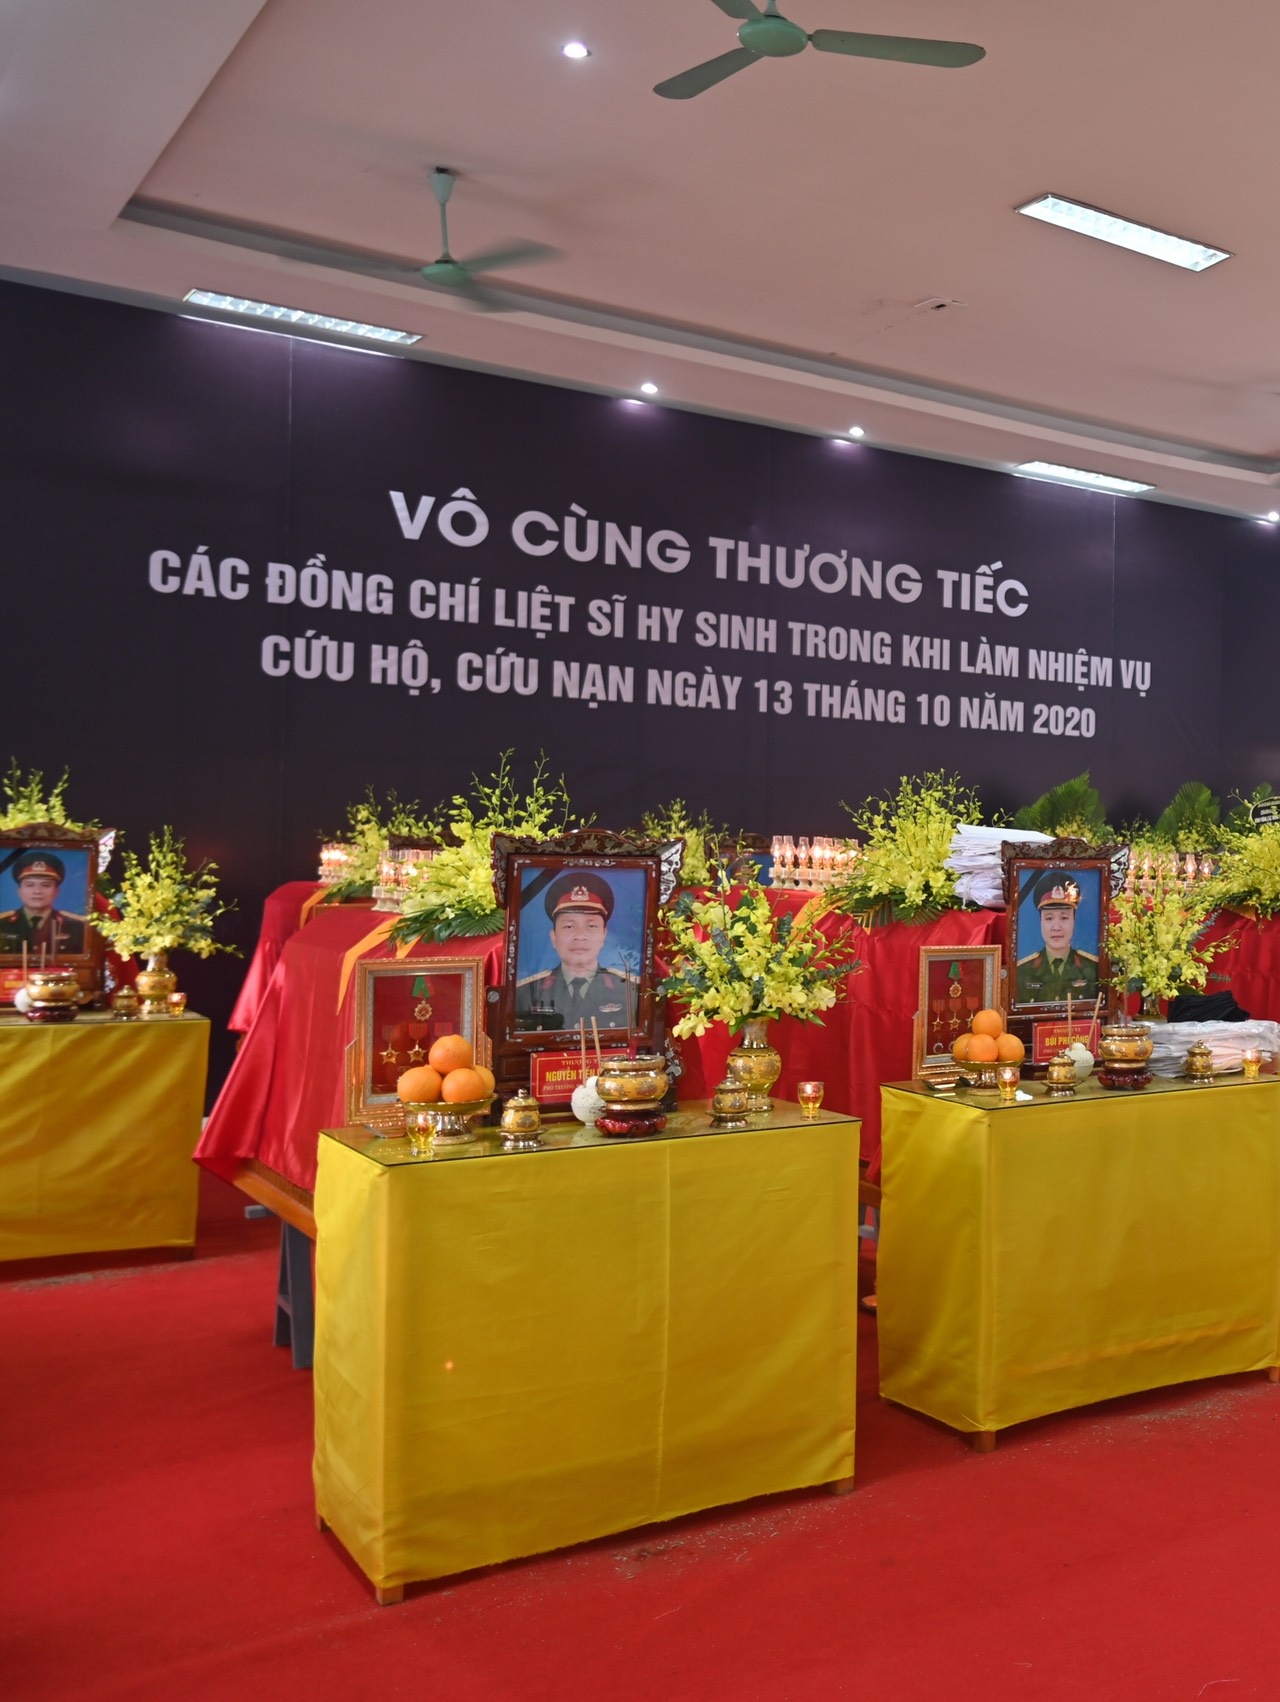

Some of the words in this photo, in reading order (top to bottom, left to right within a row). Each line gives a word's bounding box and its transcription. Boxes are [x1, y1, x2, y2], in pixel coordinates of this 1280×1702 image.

[388, 487, 489, 547] VÔ
[511, 502, 691, 573] CÙNG
[708, 536, 923, 604] THƯƠNG
[937, 560, 1029, 618] TIẾC
[149, 545, 250, 600] CÁC
[265, 553, 394, 615] ĐỒNG
[409, 577, 481, 624] CHÍ
[494, 584, 576, 639] LIỆT
[587, 594, 627, 638] SĨ
[637, 604, 684, 643] HY
[695, 611, 777, 653] SINH
[787, 621, 892, 665] TRONG
[902, 634, 951, 671] KHI
[960, 636, 1020, 678] LÀM
[1028, 647, 1113, 692] NHIỆM
[1119, 658, 1151, 698] VỤ
[261, 629, 355, 682] CỨU
[370, 639, 441, 696] HỘ,
[457, 647, 539, 696] CỨU
[552, 660, 634, 709] NẠN
[647, 665, 743, 710] NGÀY
[754, 679, 793, 715] 13
[803, 679, 906, 724] THÁNG
[916, 693, 951, 727] 10
[959, 692, 1025, 733] NĂM
[1032, 703, 1096, 738] 2020
[579, 1065, 595, 1079] TẾN
